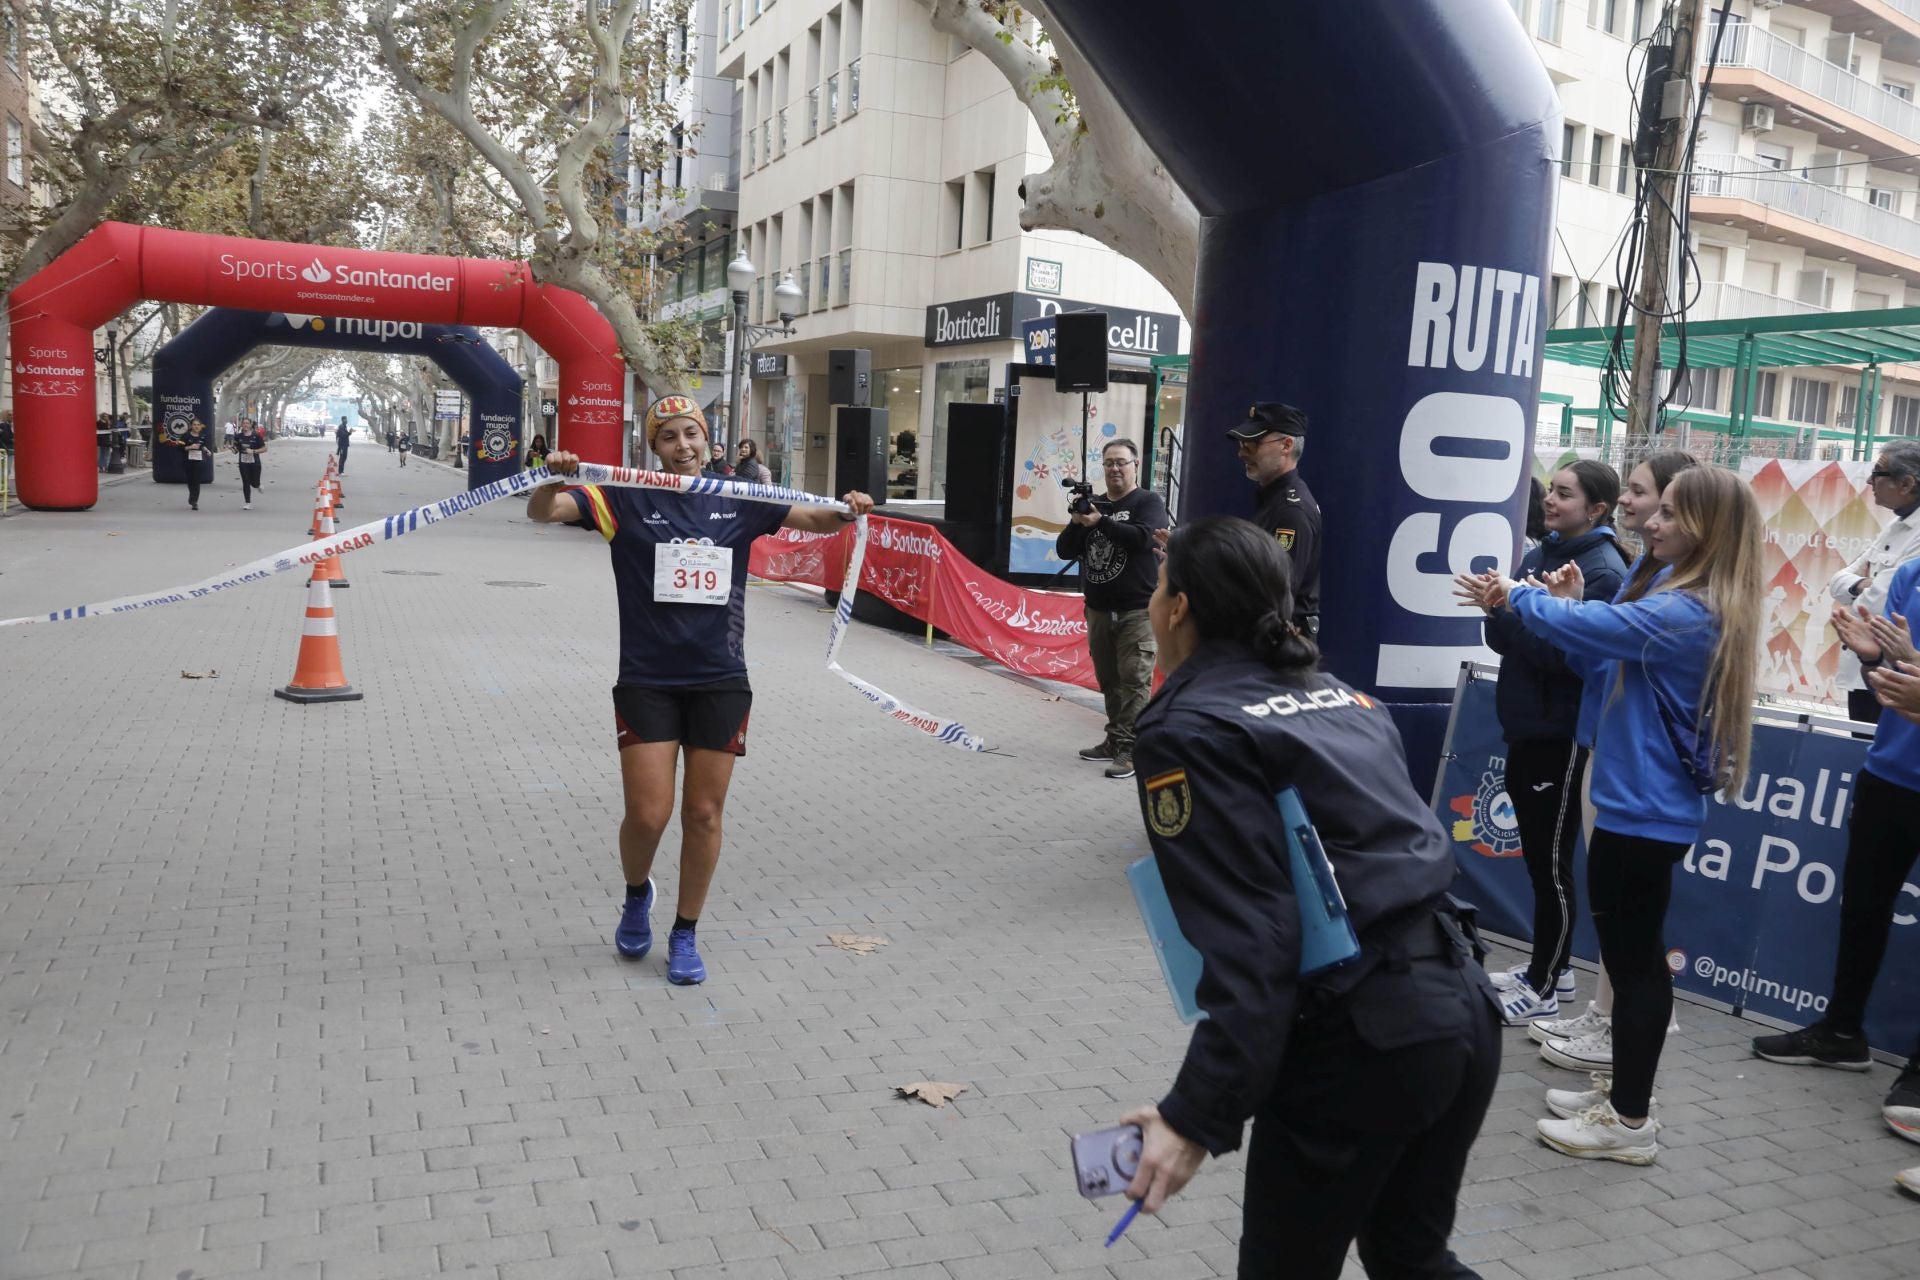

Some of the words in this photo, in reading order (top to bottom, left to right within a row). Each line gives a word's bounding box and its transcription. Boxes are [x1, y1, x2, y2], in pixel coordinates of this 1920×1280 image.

[220, 254, 297, 281] Sports
[336, 265, 454, 292] Santander
[297, 291, 375, 304] sportssantander.es
[936, 301, 1000, 343] Botticelli
[1408, 261, 1540, 378] RUTA
[29, 346, 68, 359] Sports
[26, 364, 85, 376] Santander
[757, 354, 776, 373] rebeca
[582, 380, 612, 392] Sports
[480, 413, 516, 423] fundación
[486, 422, 509, 430] mupol
[439, 479, 508, 517] NACIONAL
[508, 474, 528, 491] DE
[635, 470, 681, 488] PASAR
[324, 532, 375, 557] PASAR
[1786, 532, 1819, 548] nou
[1825, 535, 1875, 551] espa
[674, 569, 717, 591] 319
[1241, 688, 1360, 718] POLICIA
